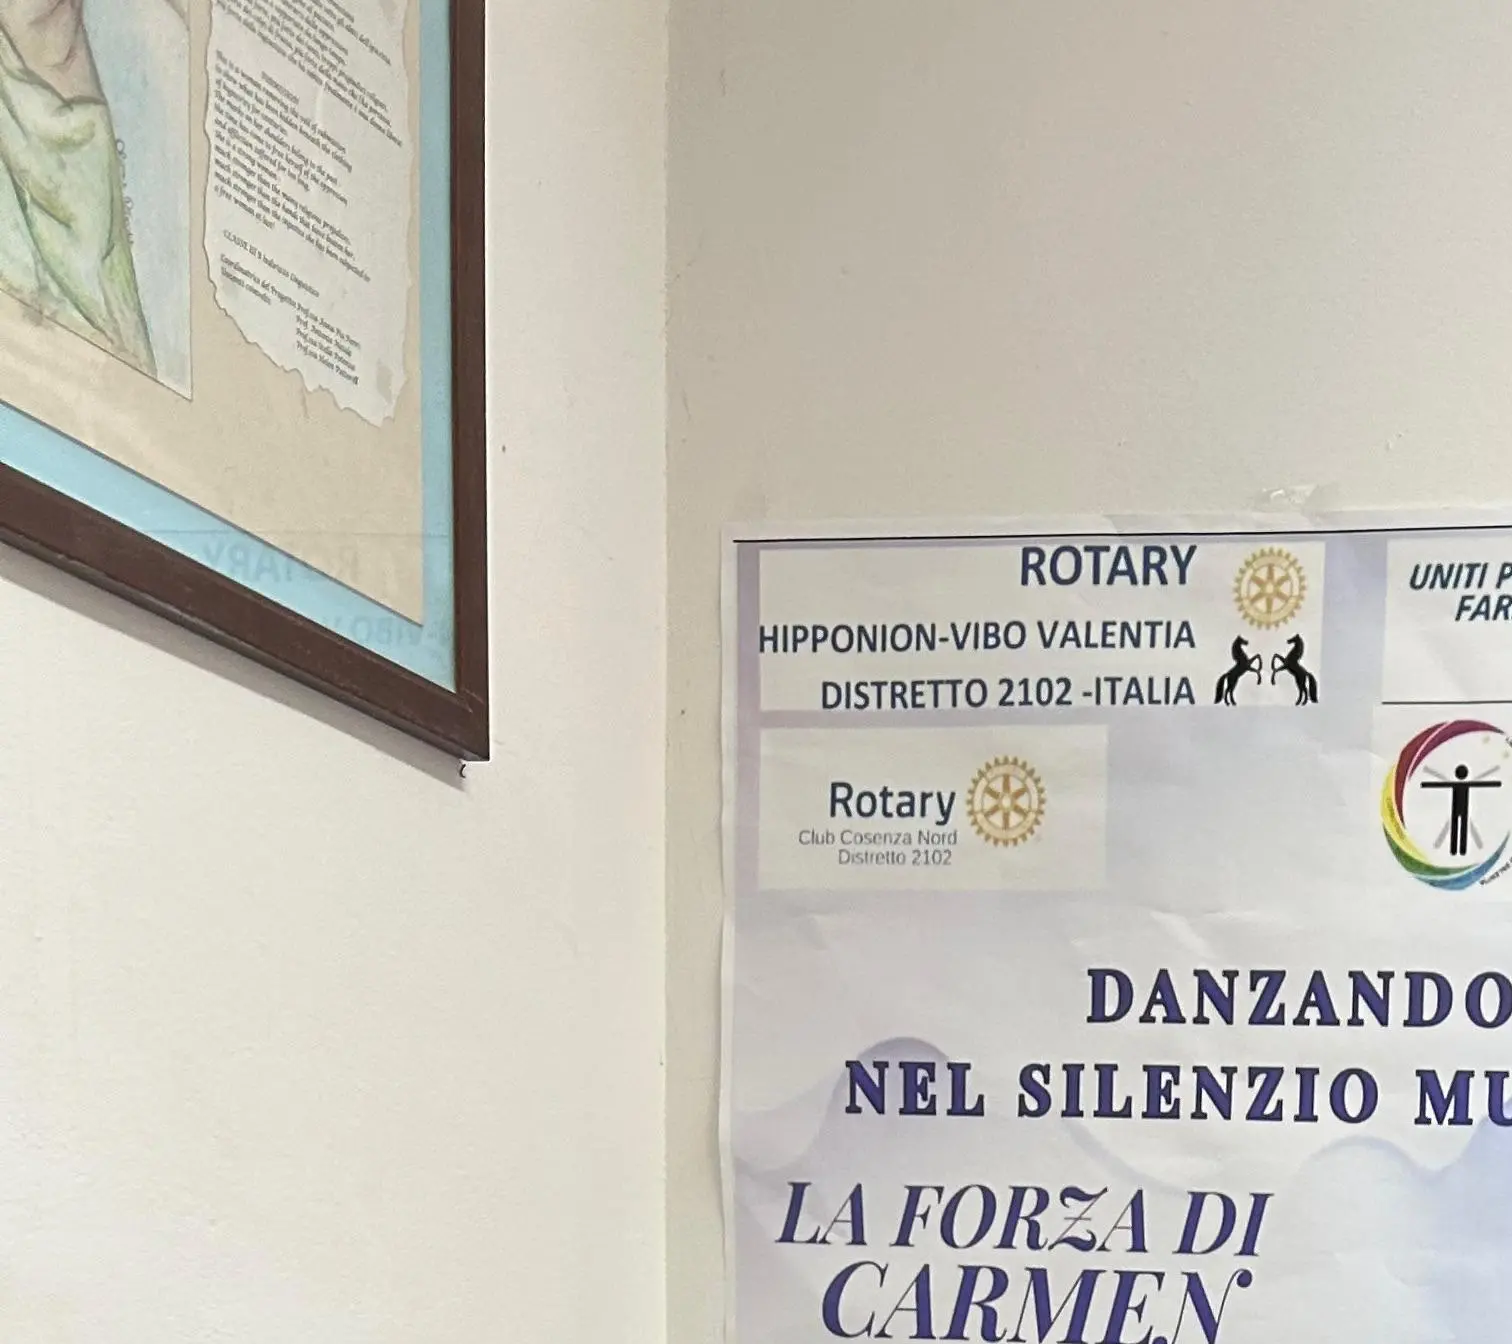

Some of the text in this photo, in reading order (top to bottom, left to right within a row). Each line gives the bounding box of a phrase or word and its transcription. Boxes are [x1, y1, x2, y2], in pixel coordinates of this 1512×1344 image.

[1021, 544, 1198, 587] ROTARY
[1410, 562, 1488, 590] UNITI
[759, 620, 1196, 653] HIPPONION-VIBO VALENTIA
[821, 678, 988, 710] DISTRETTO
[998, 677, 1072, 706] 2102
[829, 782, 956, 825] Rotary
[799, 829, 957, 846] Club Cosenza Nord
[838, 848, 952, 865] Distretto 2102
[845, 1060, 984, 1117] NEL
[1017, 1063, 1379, 1122] SILENZIO
[776, 1181, 1274, 1257] LA FORZA DI
